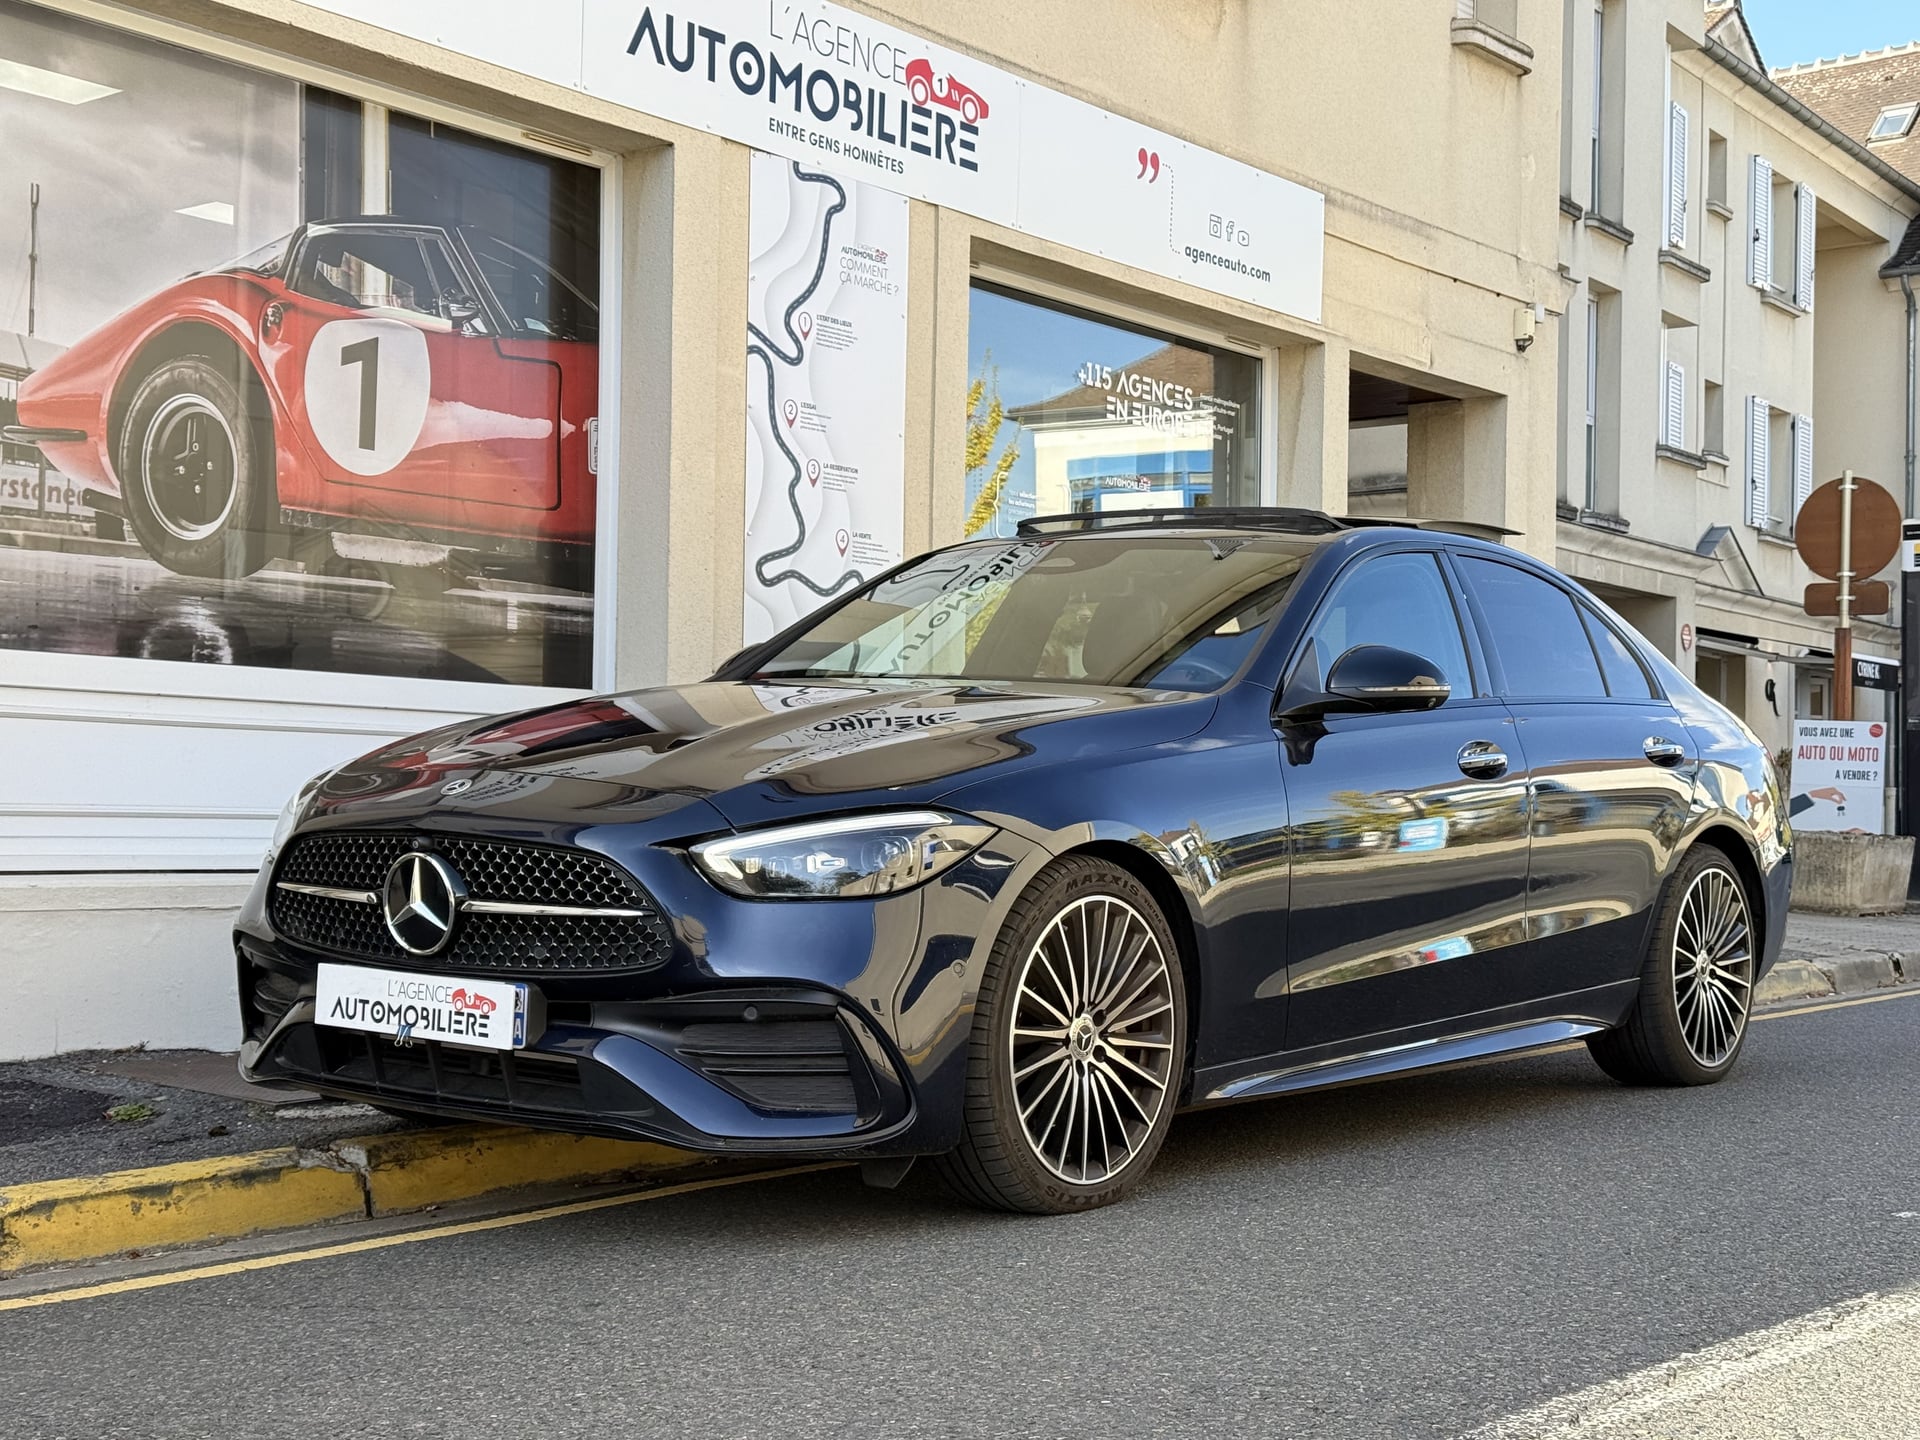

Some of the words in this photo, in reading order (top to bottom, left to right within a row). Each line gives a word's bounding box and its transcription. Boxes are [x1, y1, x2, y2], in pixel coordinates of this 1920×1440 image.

[770, 0, 907, 86] L'AGENCE
[768, 116, 806, 144] ENTRE
[808, 131, 841, 155] GENS
[843, 142, 905, 175] HONNÊTES
[839, 256, 889, 280] COMMENT
[1184, 244, 1271, 283] agenceauto.com
[839, 270, 852, 286] ÇA
[853, 274, 892, 296] MARCHE
[339, 335, 380, 452] 1
[1077, 360, 1112, 391] +115
[1115, 370, 1194, 412] AGENCES
[787, 404, 795, 415] 2
[1105, 395, 1129, 422] EN
[811, 463, 817, 475] 3
[851, 530, 859, 538] LA
[1798, 726, 1819, 738] VOUS
[1819, 726, 1838, 738] AVEZ
[1839, 727, 1855, 739] UNE
[1797, 744, 1826, 761] AUTO
[1829, 745, 1845, 762] OU
[1847, 746, 1879, 763] MOTO
[1842, 769, 1871, 781] VENDRE
[1872, 770, 1878, 781] ?
[1064, 872, 1140, 897] MAXXIS
[387, 978, 453, 1004] L'AGENCE
